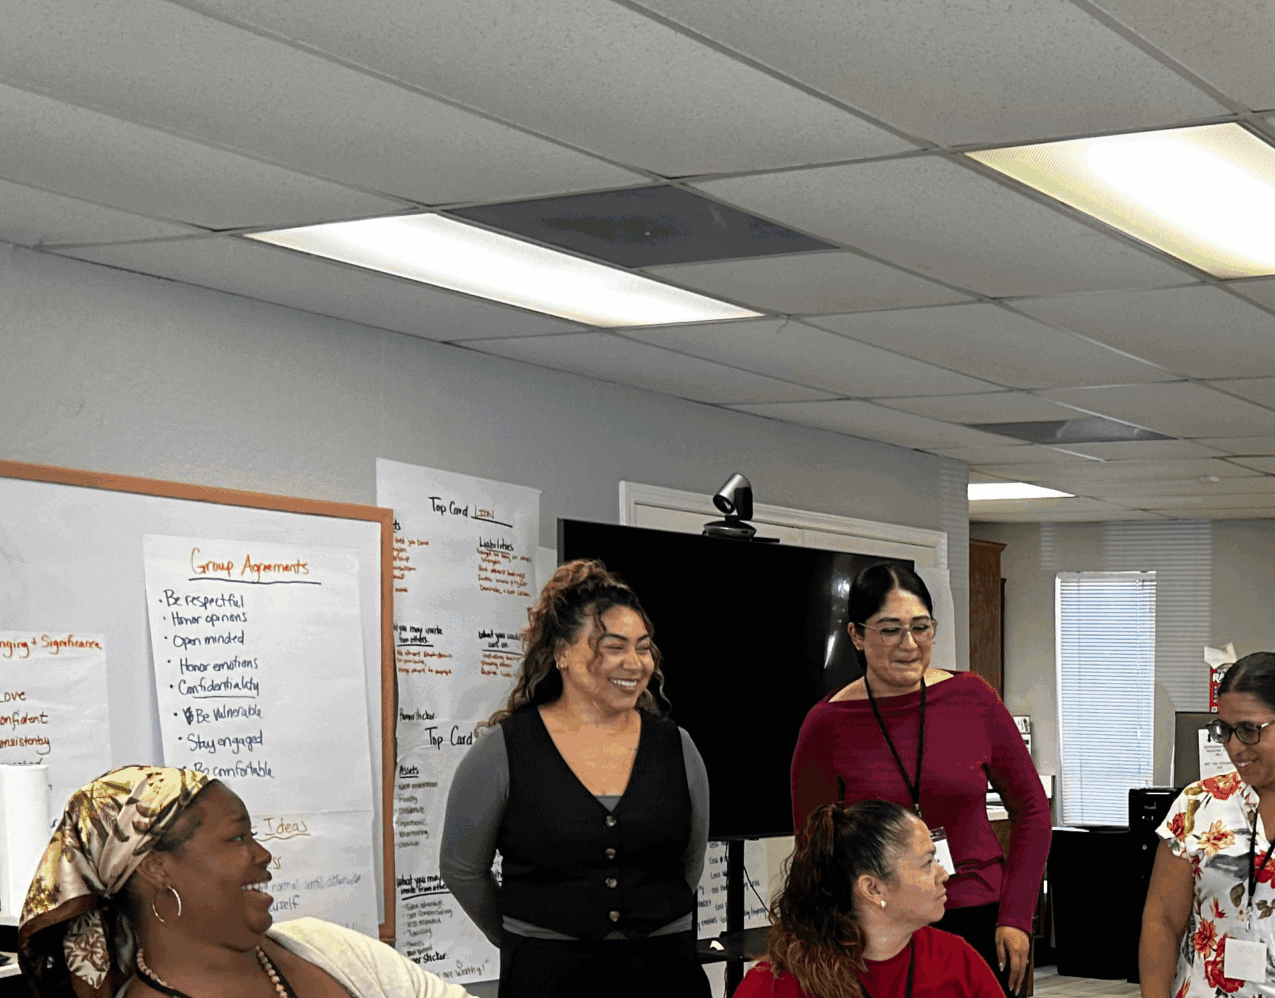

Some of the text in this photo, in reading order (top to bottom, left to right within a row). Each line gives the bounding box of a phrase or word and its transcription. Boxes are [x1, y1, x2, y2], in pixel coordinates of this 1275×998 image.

[428, 496, 447, 516] Top
[449, 501, 469, 517] Card
[191, 547, 309, 582] Group Agreements
[163, 589, 244, 609] Be respectful
[171, 612, 201, 626] Honor
[173, 629, 245, 650] Open minded
[180, 655, 258, 674] Honor emotions
[196, 709, 211, 724] Be
[187, 730, 263, 754] Stay engaged
[425, 725, 473, 750] Top Card
[212, 760, 274, 779] comfortable
[263, 817, 308, 834] Ideas
